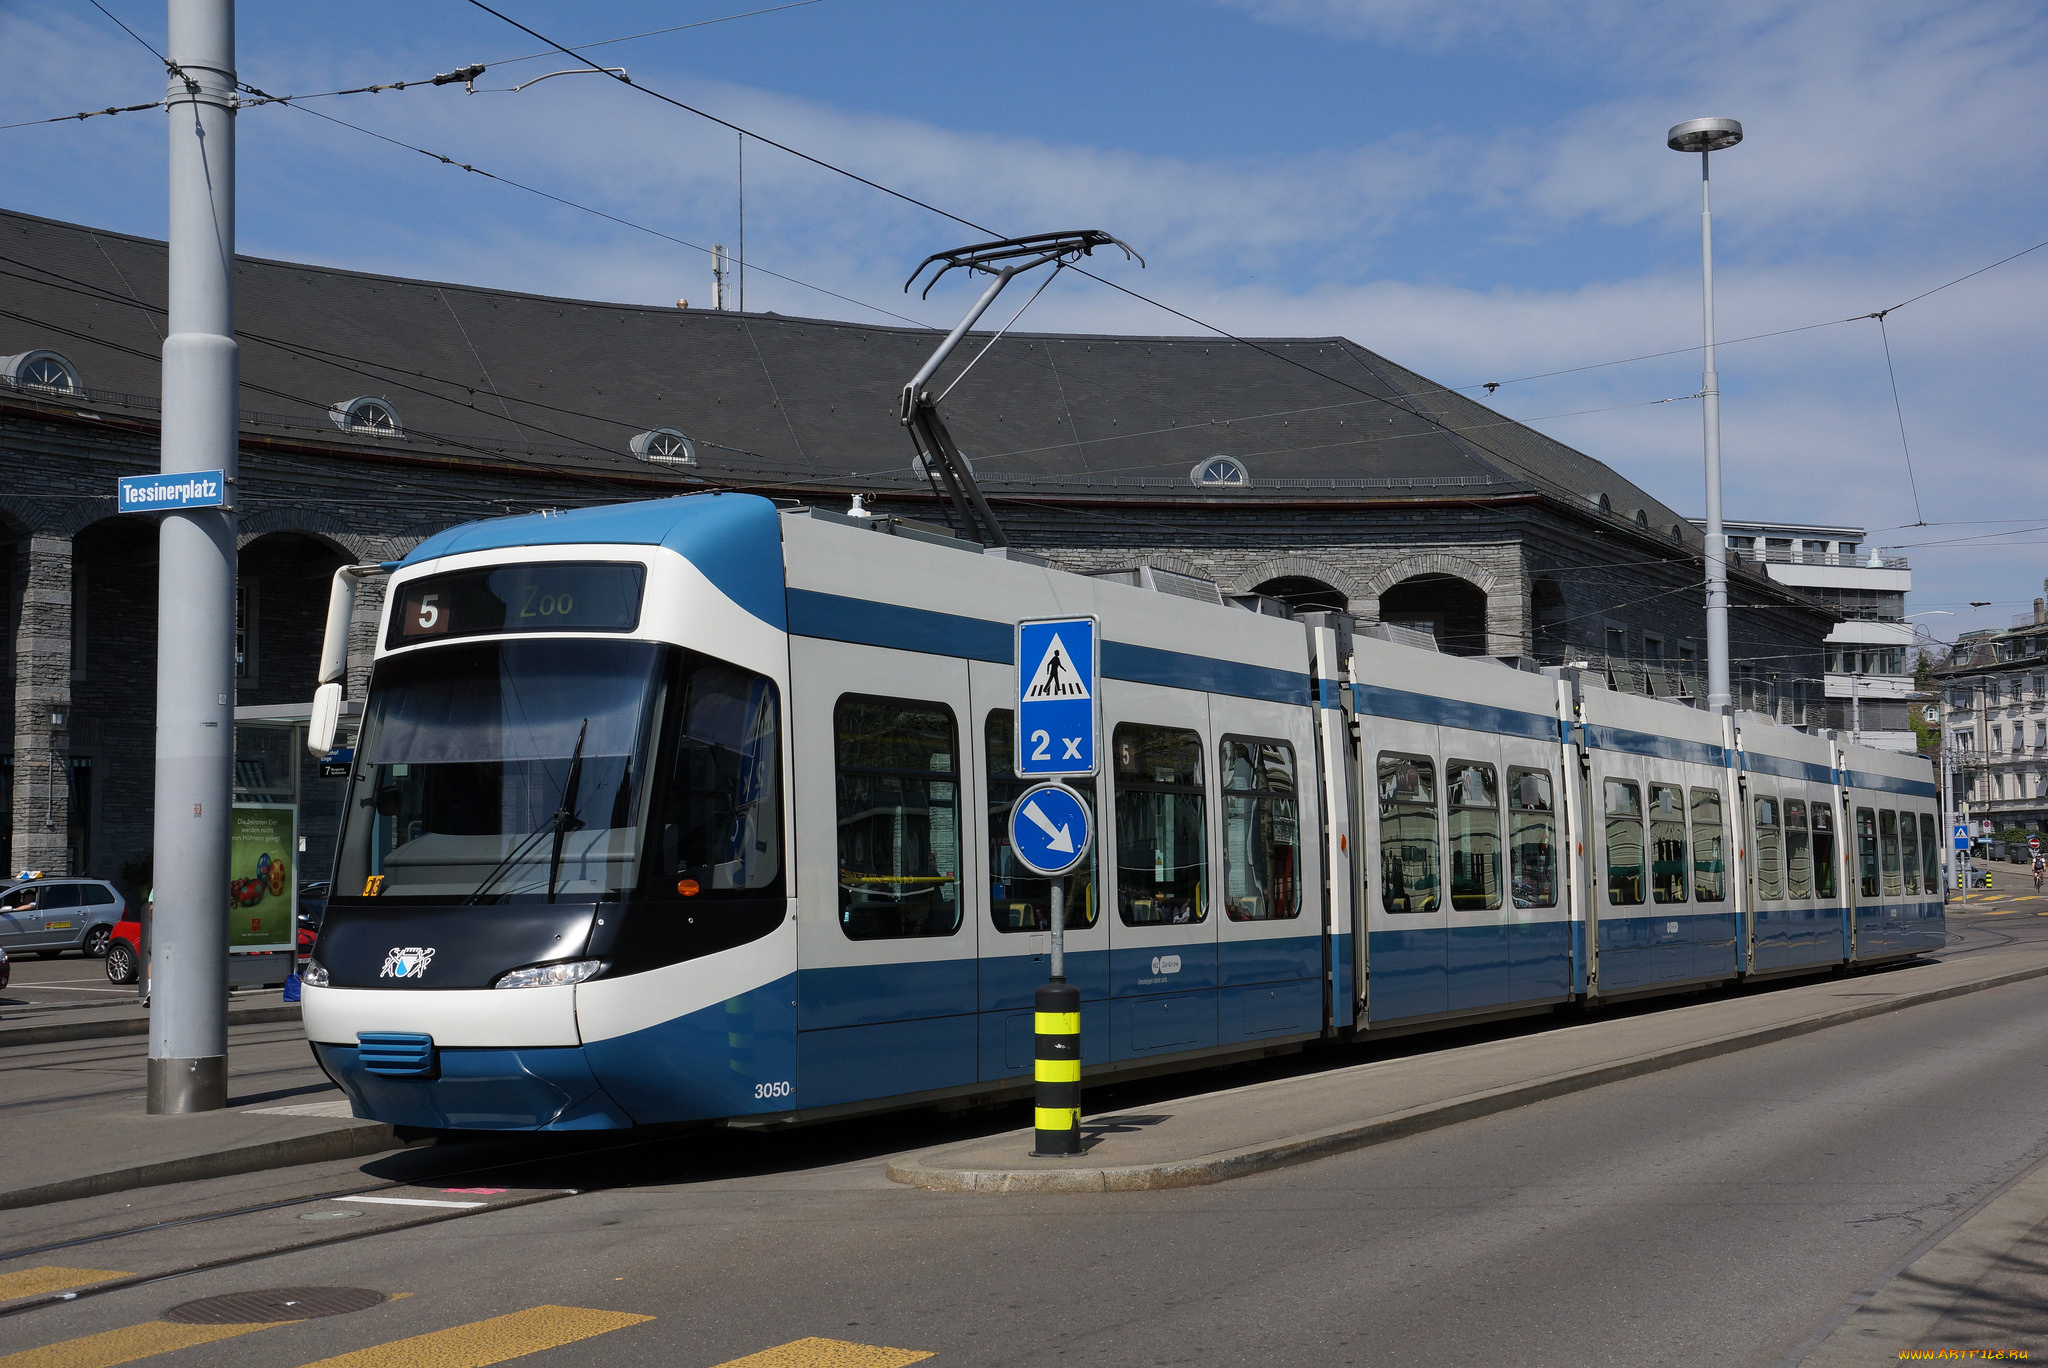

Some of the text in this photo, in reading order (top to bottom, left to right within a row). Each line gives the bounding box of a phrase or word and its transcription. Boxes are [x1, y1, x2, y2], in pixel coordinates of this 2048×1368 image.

[123, 479, 217, 504] Tessinerplatz
[418, 586, 573, 629] 5 Zoo
[1030, 729, 1083, 761] 2 x
[1122, 743, 1130, 765] 5
[325, 766, 331, 776] 7
[365, 879, 381, 894] 03
[754, 1080, 790, 1099] 3050
